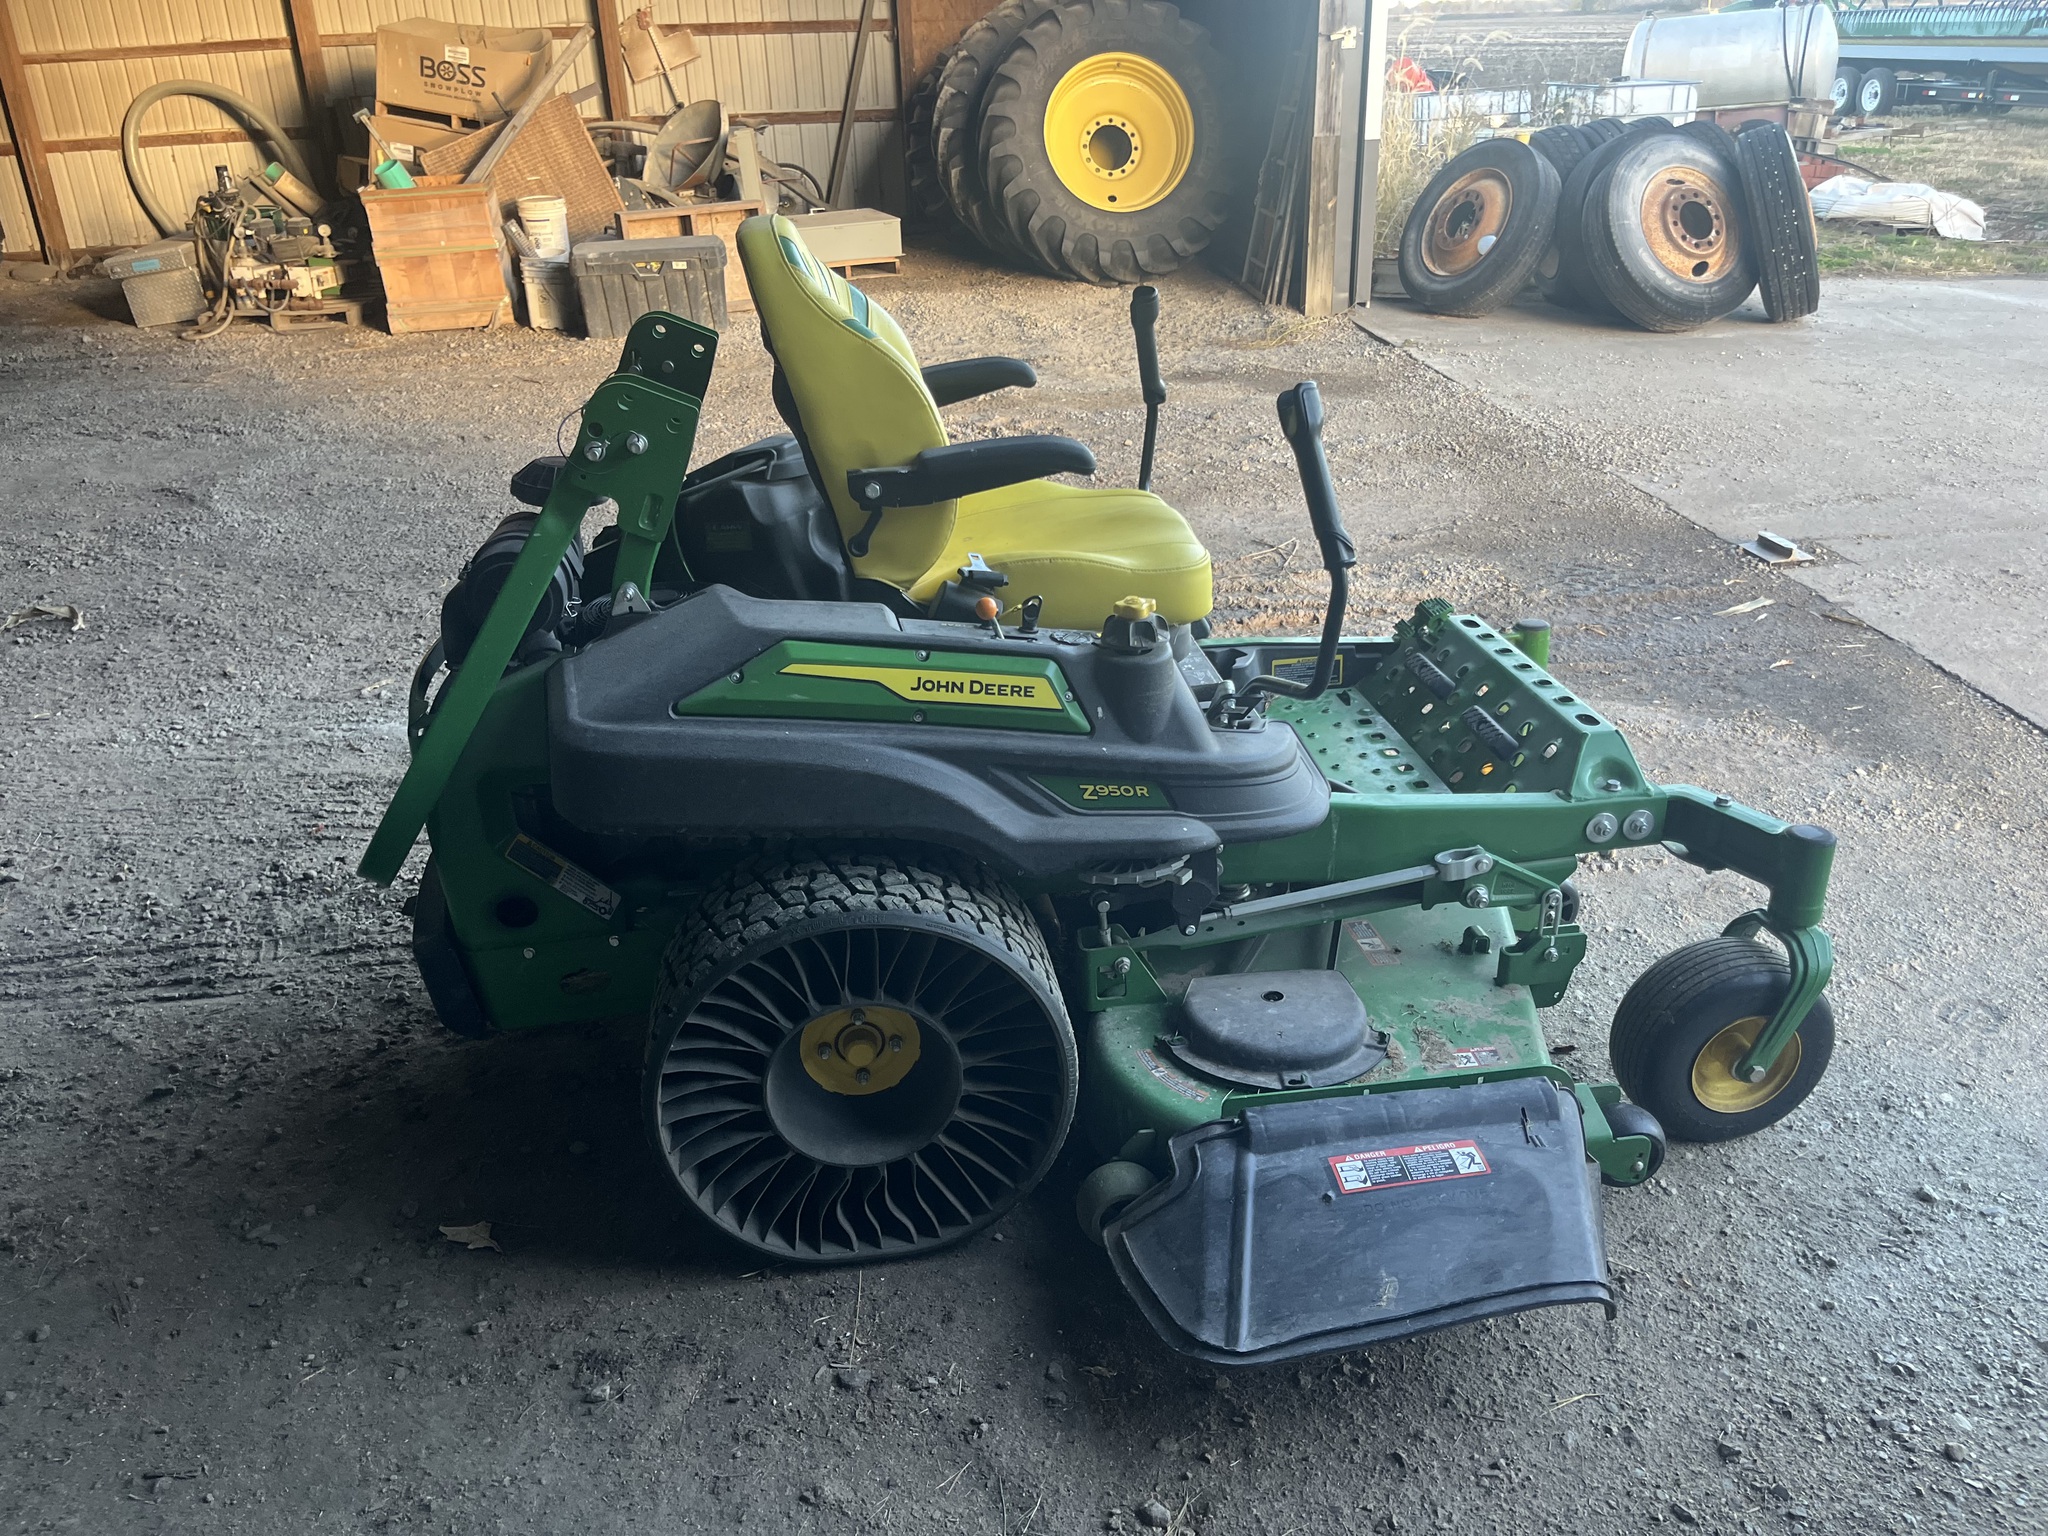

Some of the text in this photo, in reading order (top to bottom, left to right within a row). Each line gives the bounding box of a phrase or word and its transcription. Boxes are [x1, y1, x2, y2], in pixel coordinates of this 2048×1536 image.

[420, 56, 486, 88] BOSS
[424, 81, 482, 96] SNOWPLOW
[910, 677, 1035, 698] JOHN DEERE
[1079, 785, 1149, 800] Z950R
[1421, 1142, 1456, 1152] PELIGRO
[1353, 1151, 1387, 1160] DANGER
